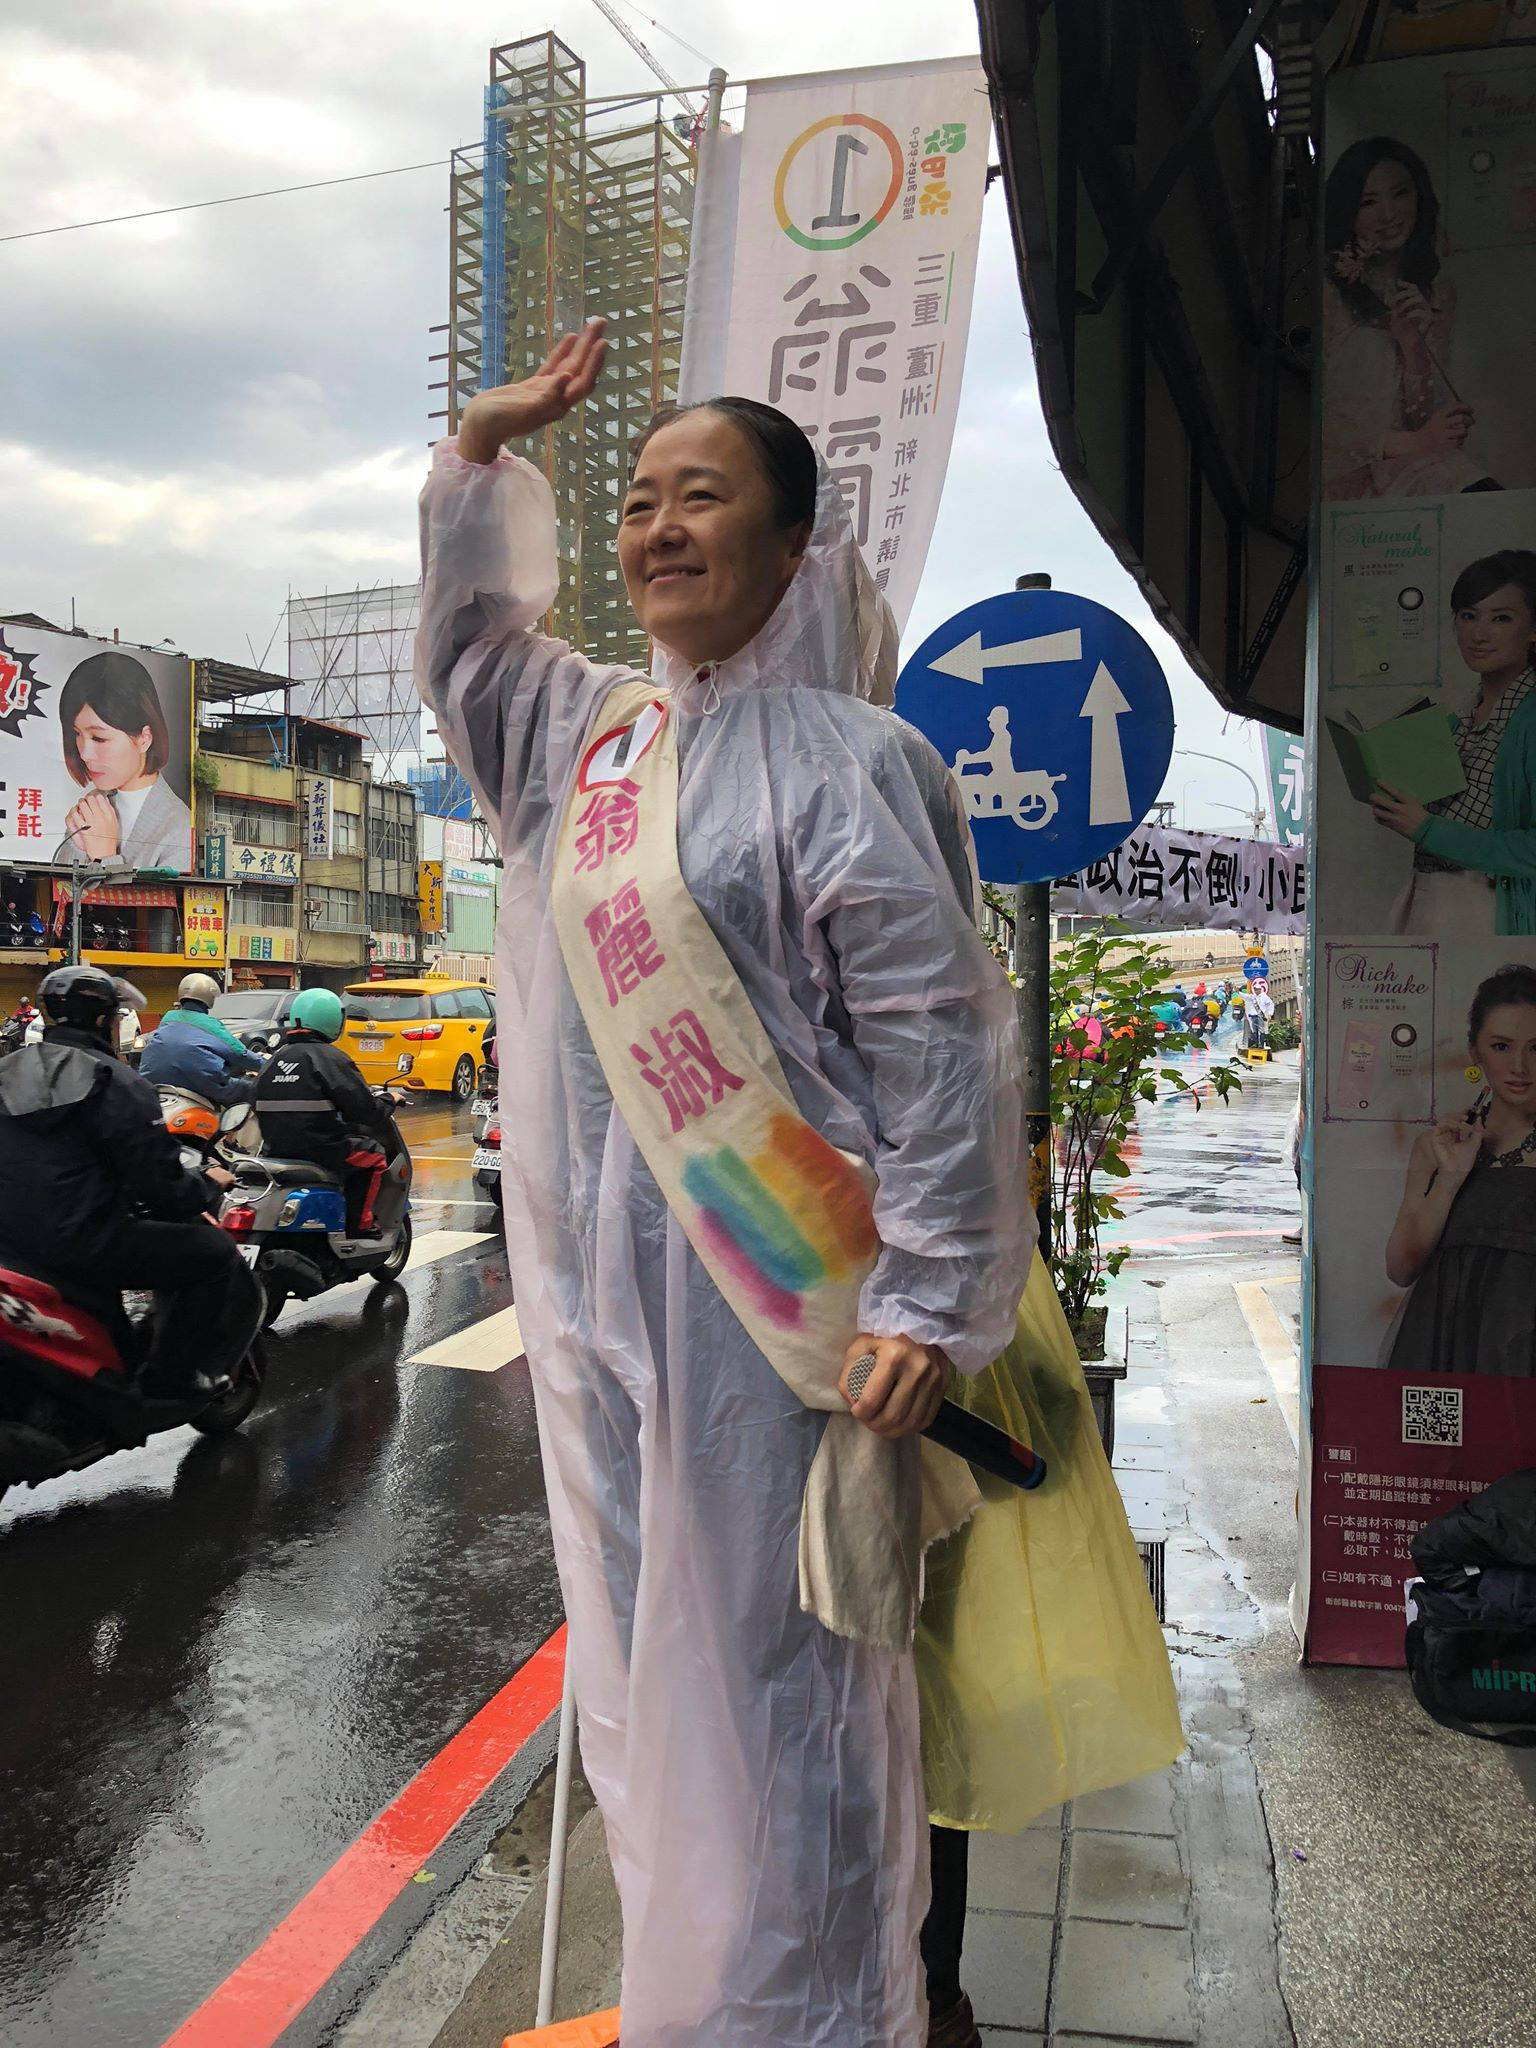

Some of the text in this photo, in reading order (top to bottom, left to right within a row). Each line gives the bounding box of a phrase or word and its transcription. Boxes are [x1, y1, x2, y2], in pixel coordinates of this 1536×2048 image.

[1337, 522, 1421, 548] Natural
[1383, 541, 1432, 559] make
[17, 787, 42, 838] 拜託
[232, 847, 297, 877] 命禮儀
[187, 915, 224, 931] 好機車
[574, 777, 746, 1134] 翁麗淑
[1335, 953, 1397, 982] Rich
[1373, 975, 1429, 994] make
[272, 1075, 300, 1083] JUMP
[1328, 1448, 1351, 1461] 警語
